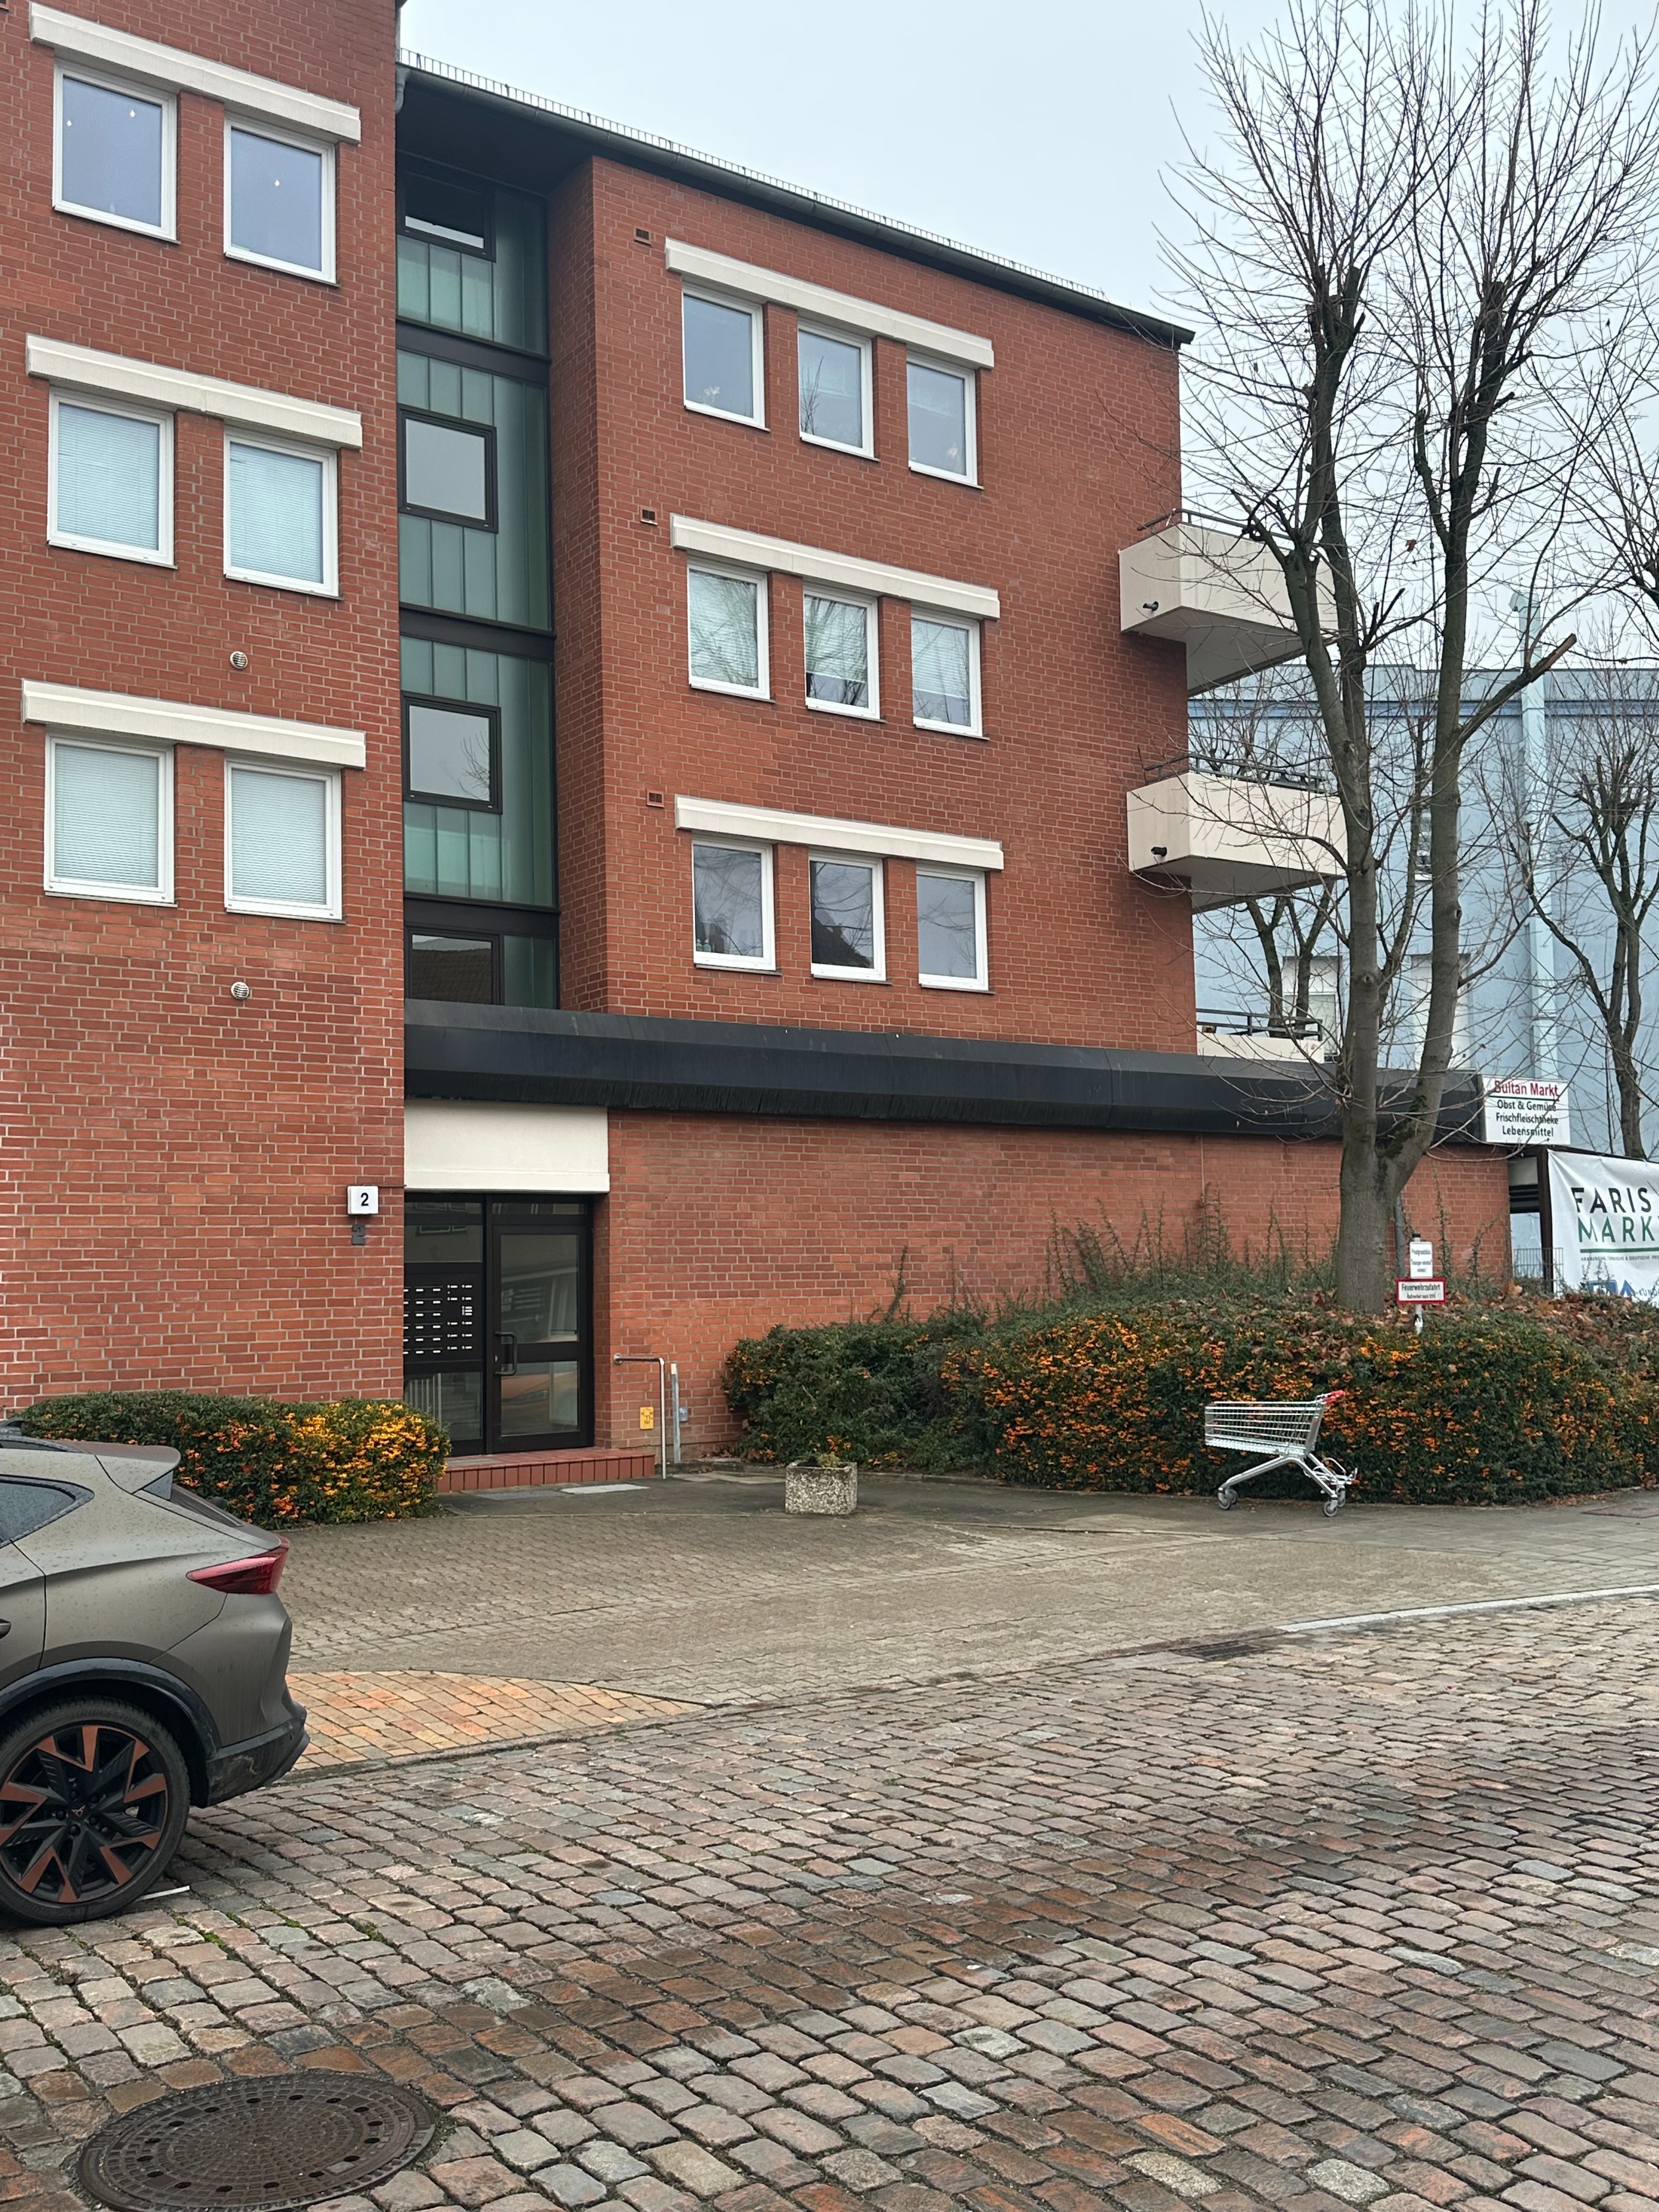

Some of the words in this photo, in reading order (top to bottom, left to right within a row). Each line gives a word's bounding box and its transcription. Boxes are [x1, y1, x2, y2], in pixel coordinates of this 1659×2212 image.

[1530, 1083, 1558, 1097] Markt
[1497, 1099, 1515, 1109] Obst
[1517, 1101, 1525, 1110] &
[1496, 1113, 1559, 1125] Frischfleischtheke
[1502, 1125, 1554, 1137] Lebensmittel
[360, 1192, 369, 1206] 2
[1571, 1187, 1651, 1214] FARIS
[352, 1224, 365, 1245] 2
[1577, 1216, 1659, 1243] MARK
